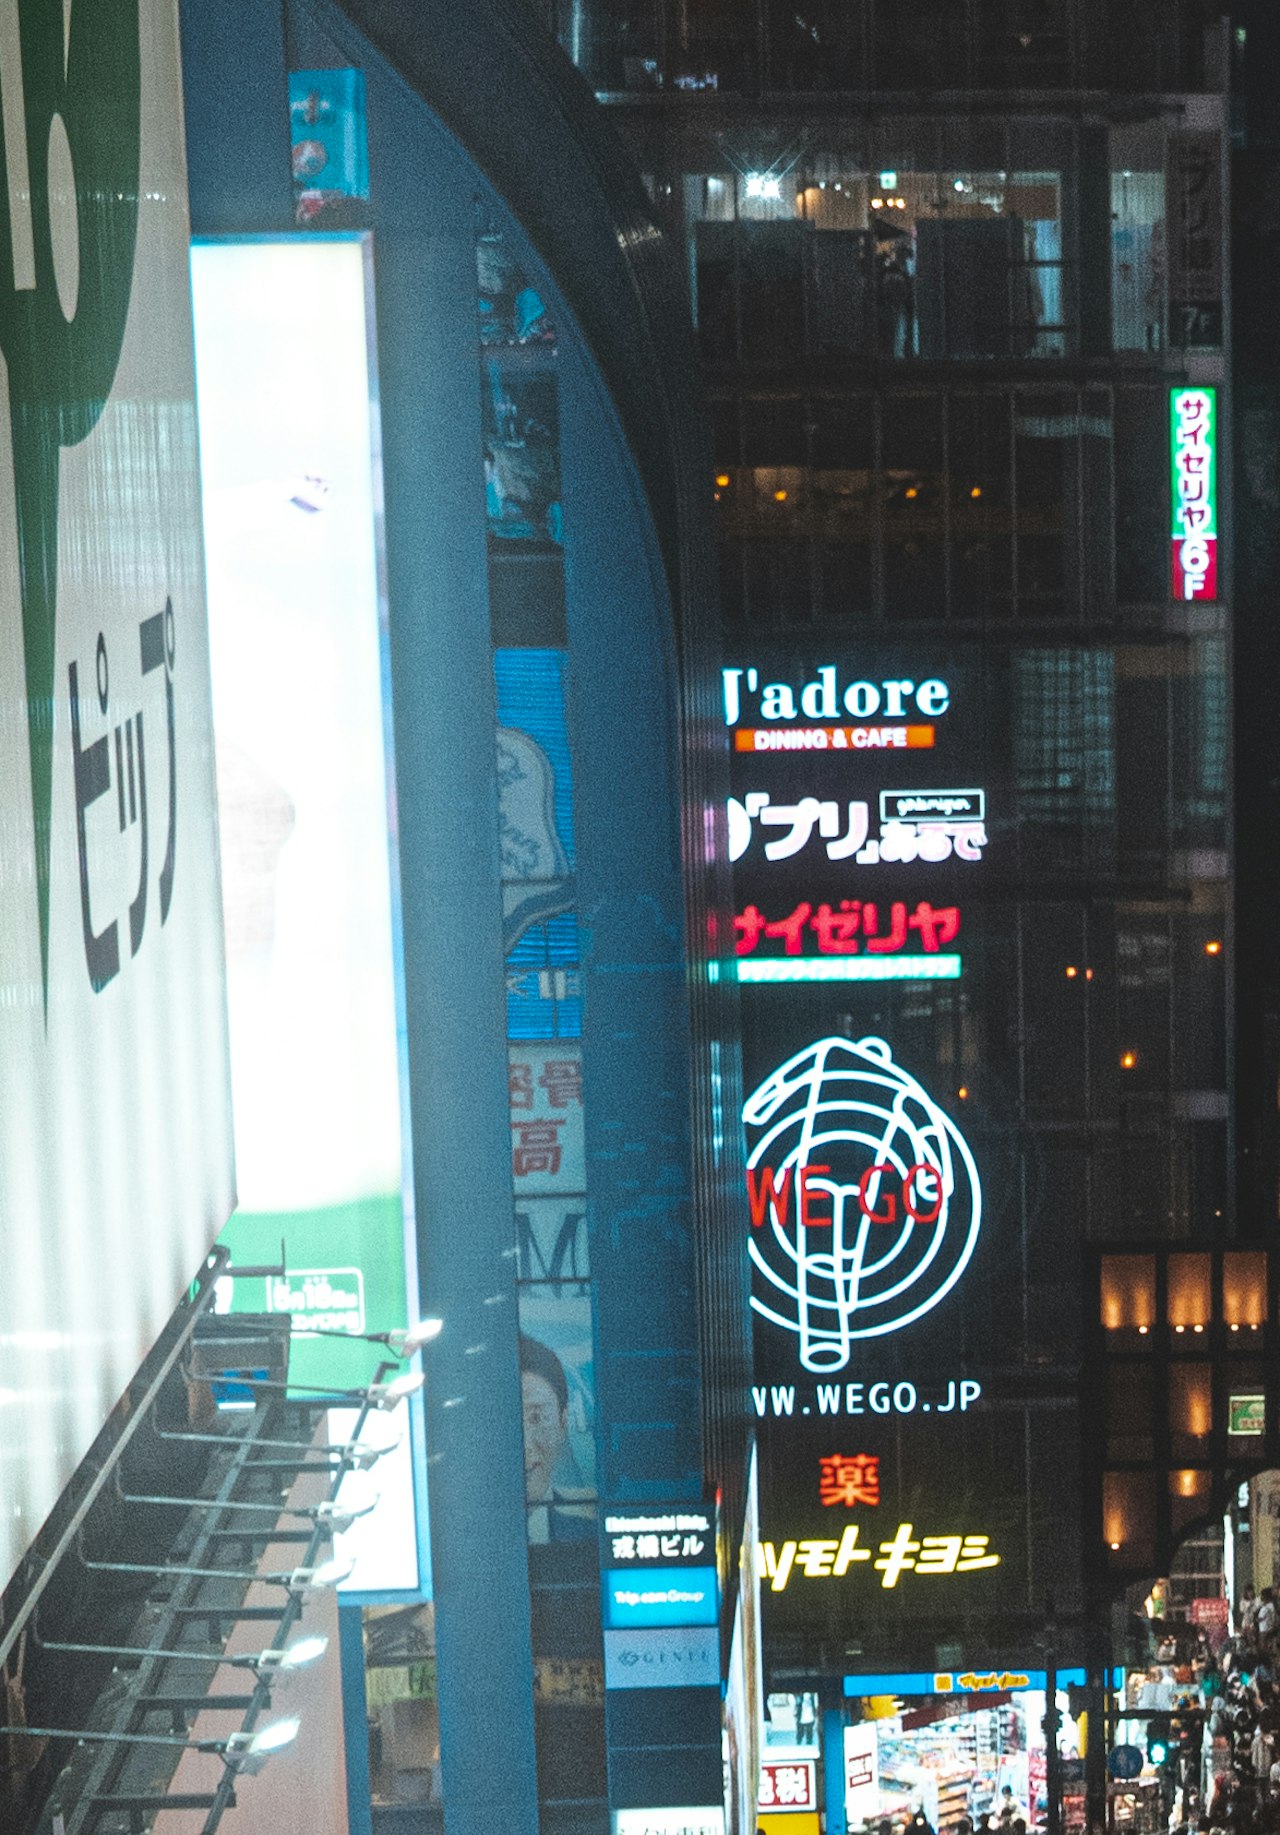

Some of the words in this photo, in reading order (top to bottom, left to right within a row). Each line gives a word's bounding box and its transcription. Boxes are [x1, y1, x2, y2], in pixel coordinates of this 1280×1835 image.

[1179, 537, 1210, 600] 6F
[722, 665, 950, 726] J'adore
[754, 728, 829, 751] DINING
[831, 727, 849, 749] &
[851, 726, 907, 748] CAFE
[68, 595, 177, 993] ピップ
[818, 1453, 880, 1506] 薬
